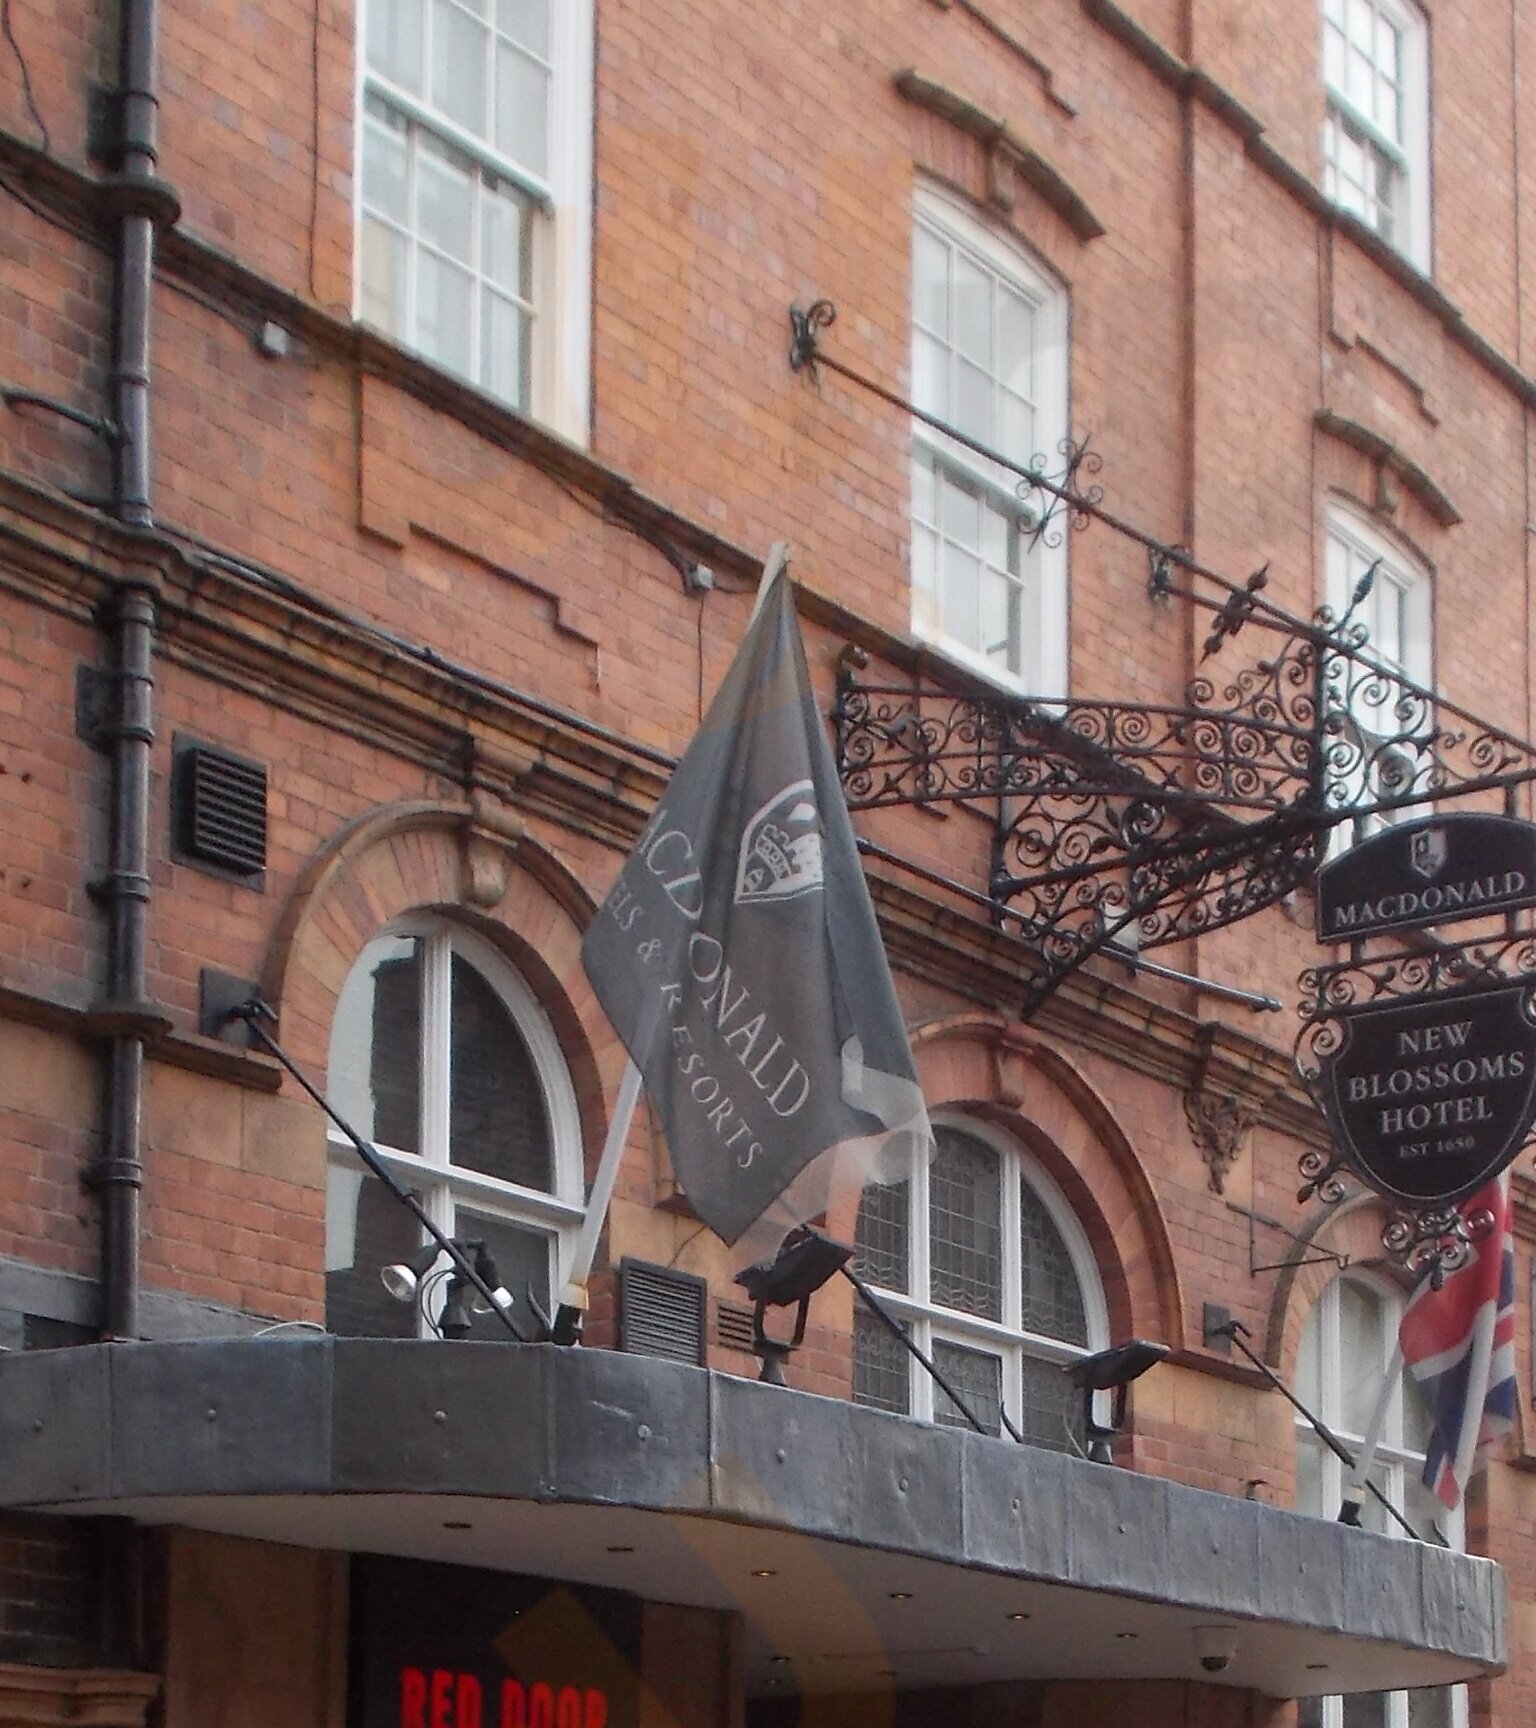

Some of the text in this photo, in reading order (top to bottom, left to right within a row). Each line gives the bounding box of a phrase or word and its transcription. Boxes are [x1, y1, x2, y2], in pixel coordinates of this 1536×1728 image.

[1334, 871, 1526, 928] MACDONALD
[1398, 1020, 1473, 1056] NEW
[660, 983, 763, 1168] RESORTS
[1348, 1051, 1526, 1101] BLOSSOMS
[1380, 1096, 1493, 1135] HOTEL
[1399, 1142, 1430, 1158] EST
